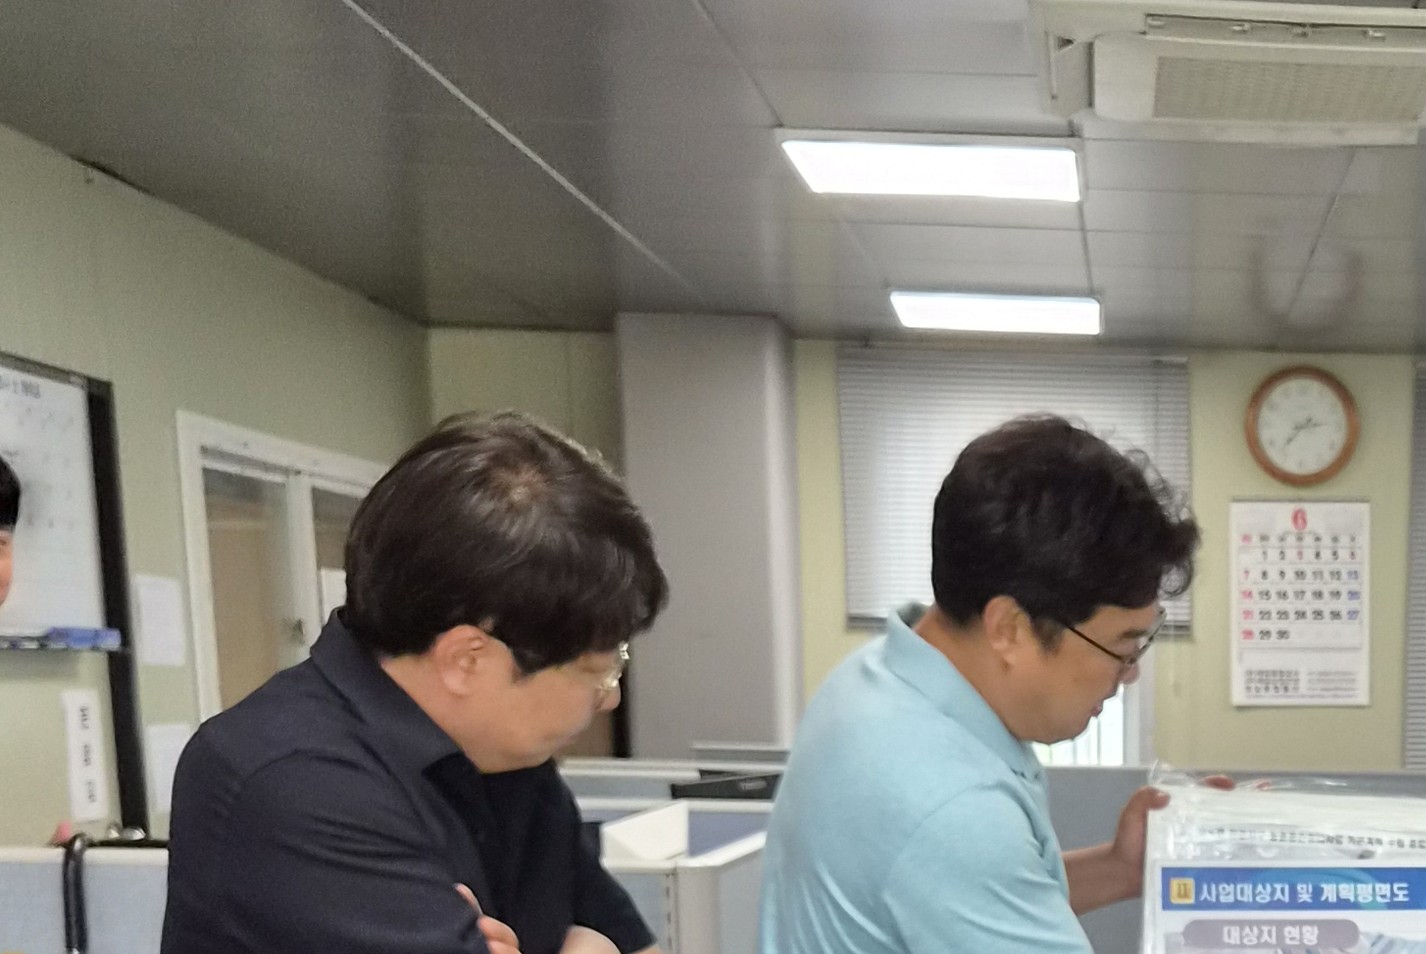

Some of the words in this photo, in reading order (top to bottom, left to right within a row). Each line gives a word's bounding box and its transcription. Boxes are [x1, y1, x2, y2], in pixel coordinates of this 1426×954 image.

[1292, 508, 1307, 531] 6
[1200, 882, 1290, 903] 사업대상지
[1296, 883, 1313, 902] 및
[1320, 882, 1410, 903] 계획평면도
[1222, 925, 1277, 945] 대상지
[1284, 925, 1319, 945] 현황
